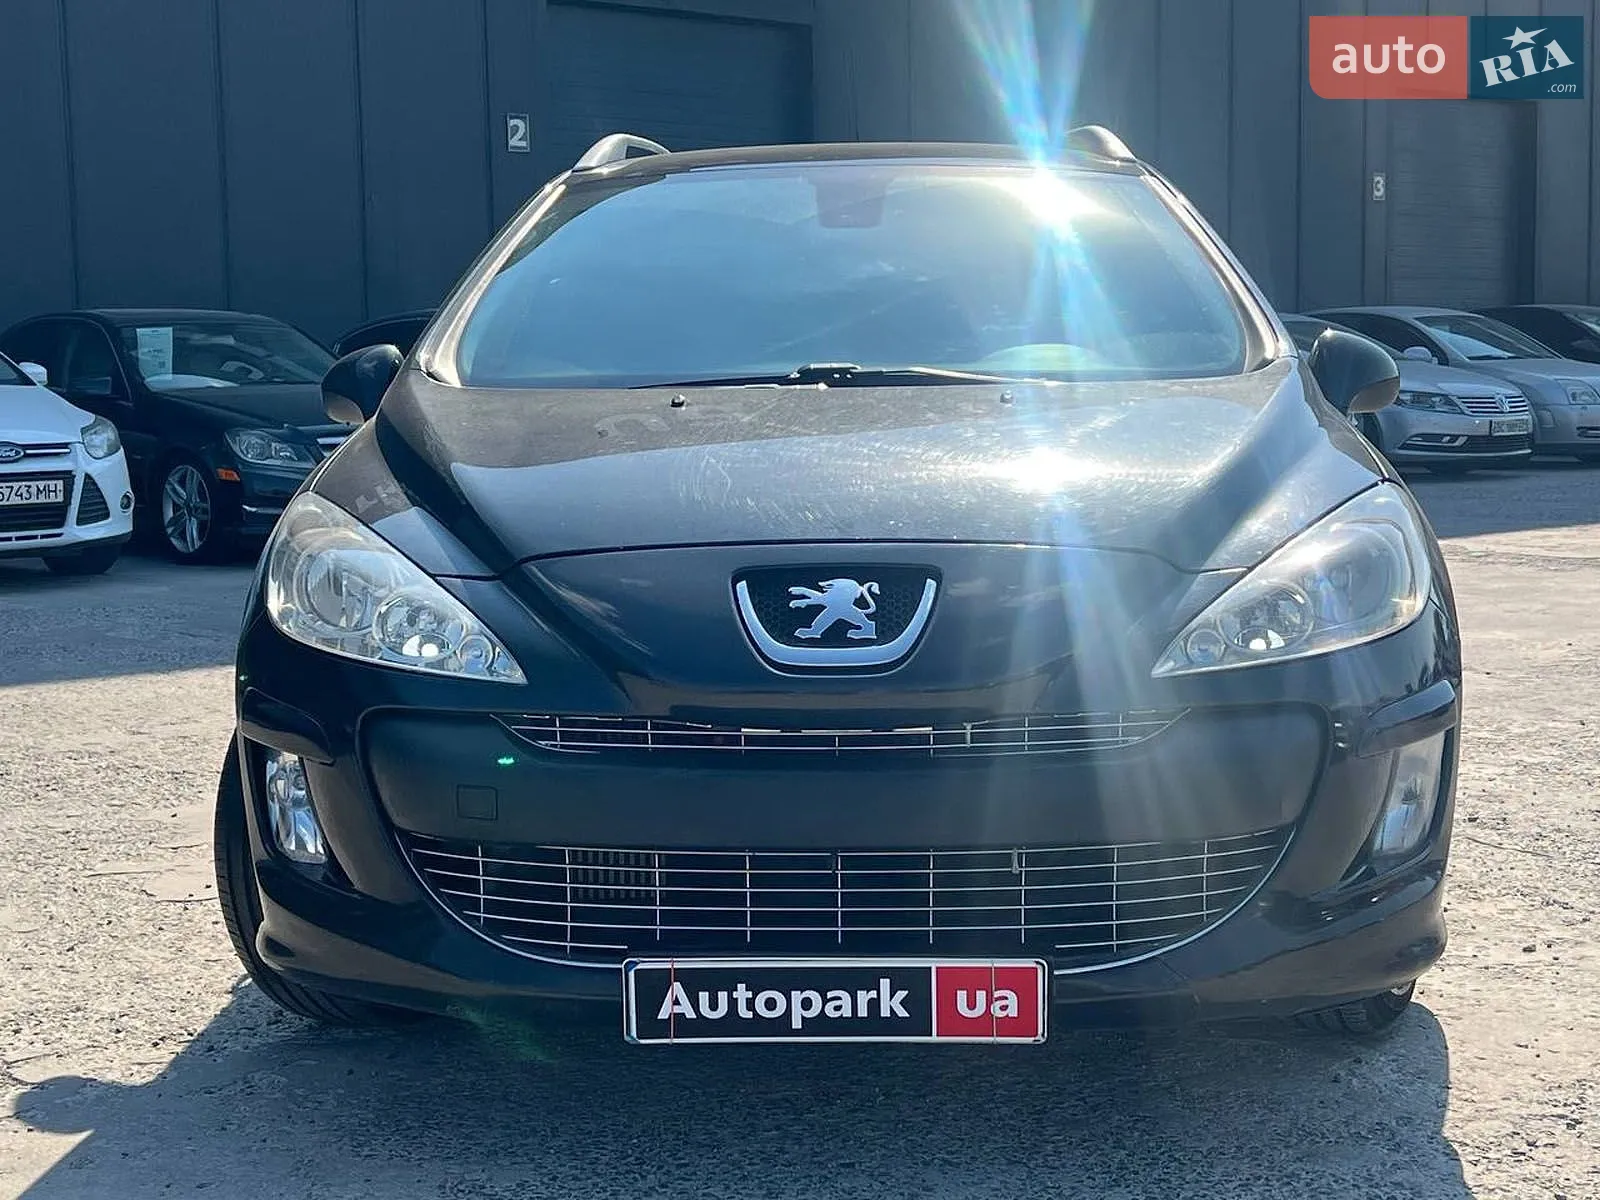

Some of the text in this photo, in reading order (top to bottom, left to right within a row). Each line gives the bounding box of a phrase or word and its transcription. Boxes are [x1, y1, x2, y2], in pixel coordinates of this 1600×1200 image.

[509, 118, 527, 147] 2
[1374, 175, 1385, 197] 3
[657, 978, 1019, 1030] Autopark ua
